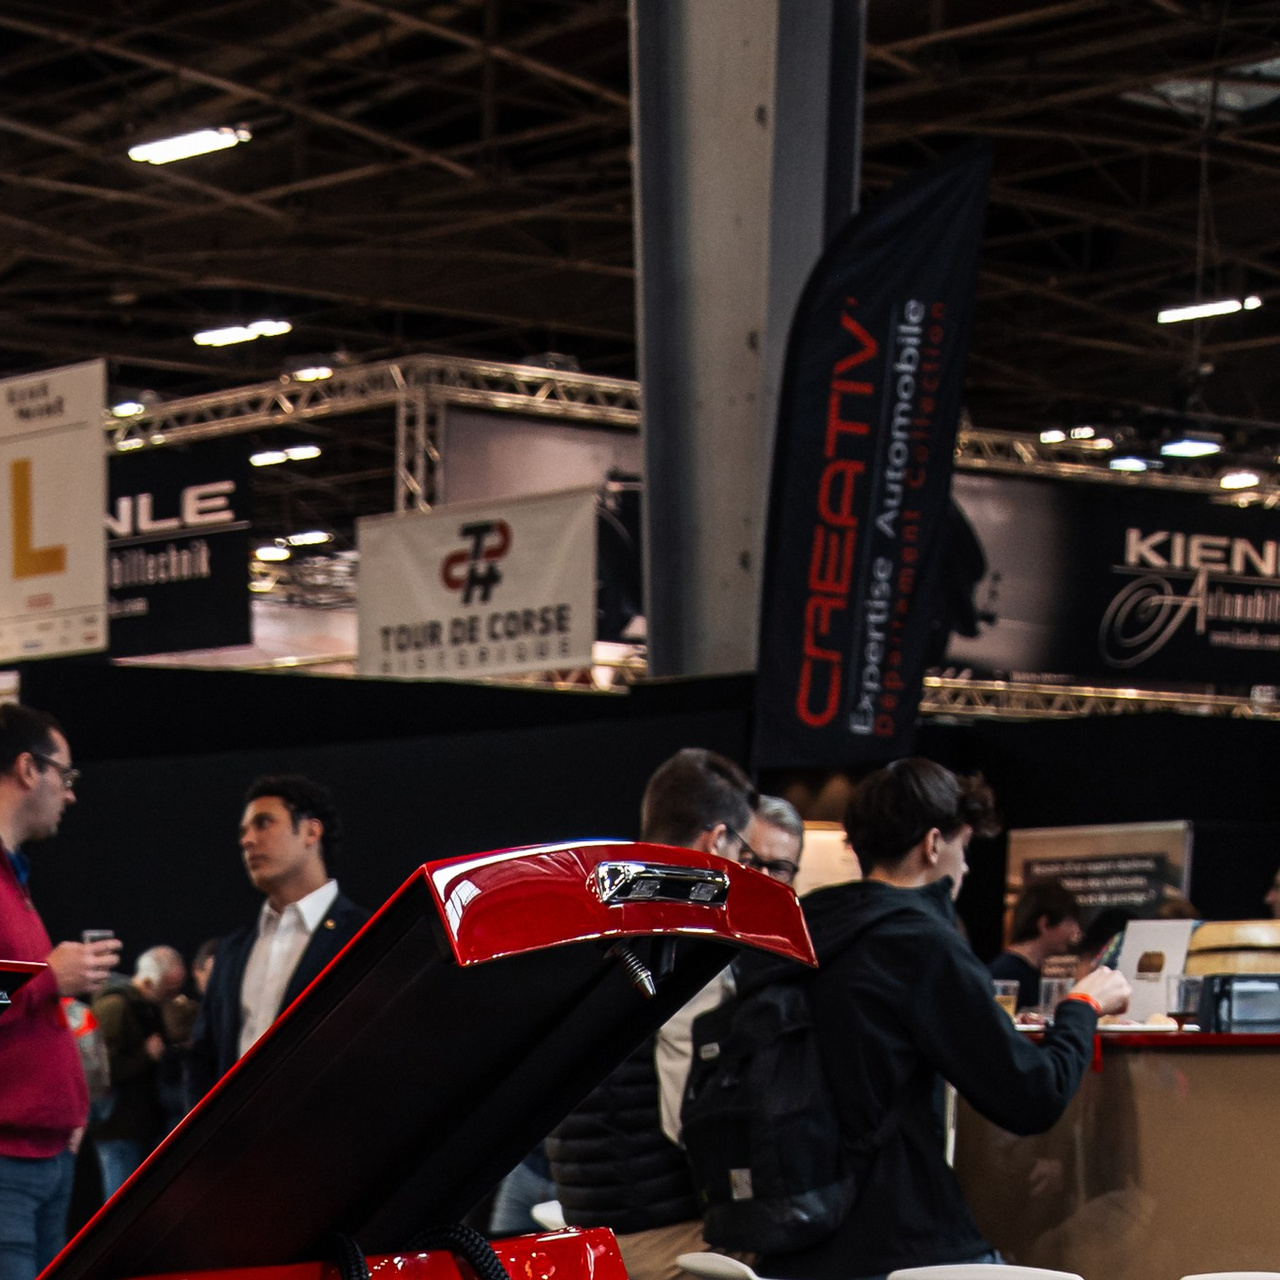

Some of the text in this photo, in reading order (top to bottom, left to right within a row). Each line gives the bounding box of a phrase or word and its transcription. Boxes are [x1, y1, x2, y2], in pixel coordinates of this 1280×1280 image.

[906, 301, 947, 488] Collection
[11, 458, 67, 580] L
[850, 299, 926, 735] Expertise Automobile
[1124, 526, 1280, 577] KIEN
[379, 603, 571, 653] TOUR DE CORSE
